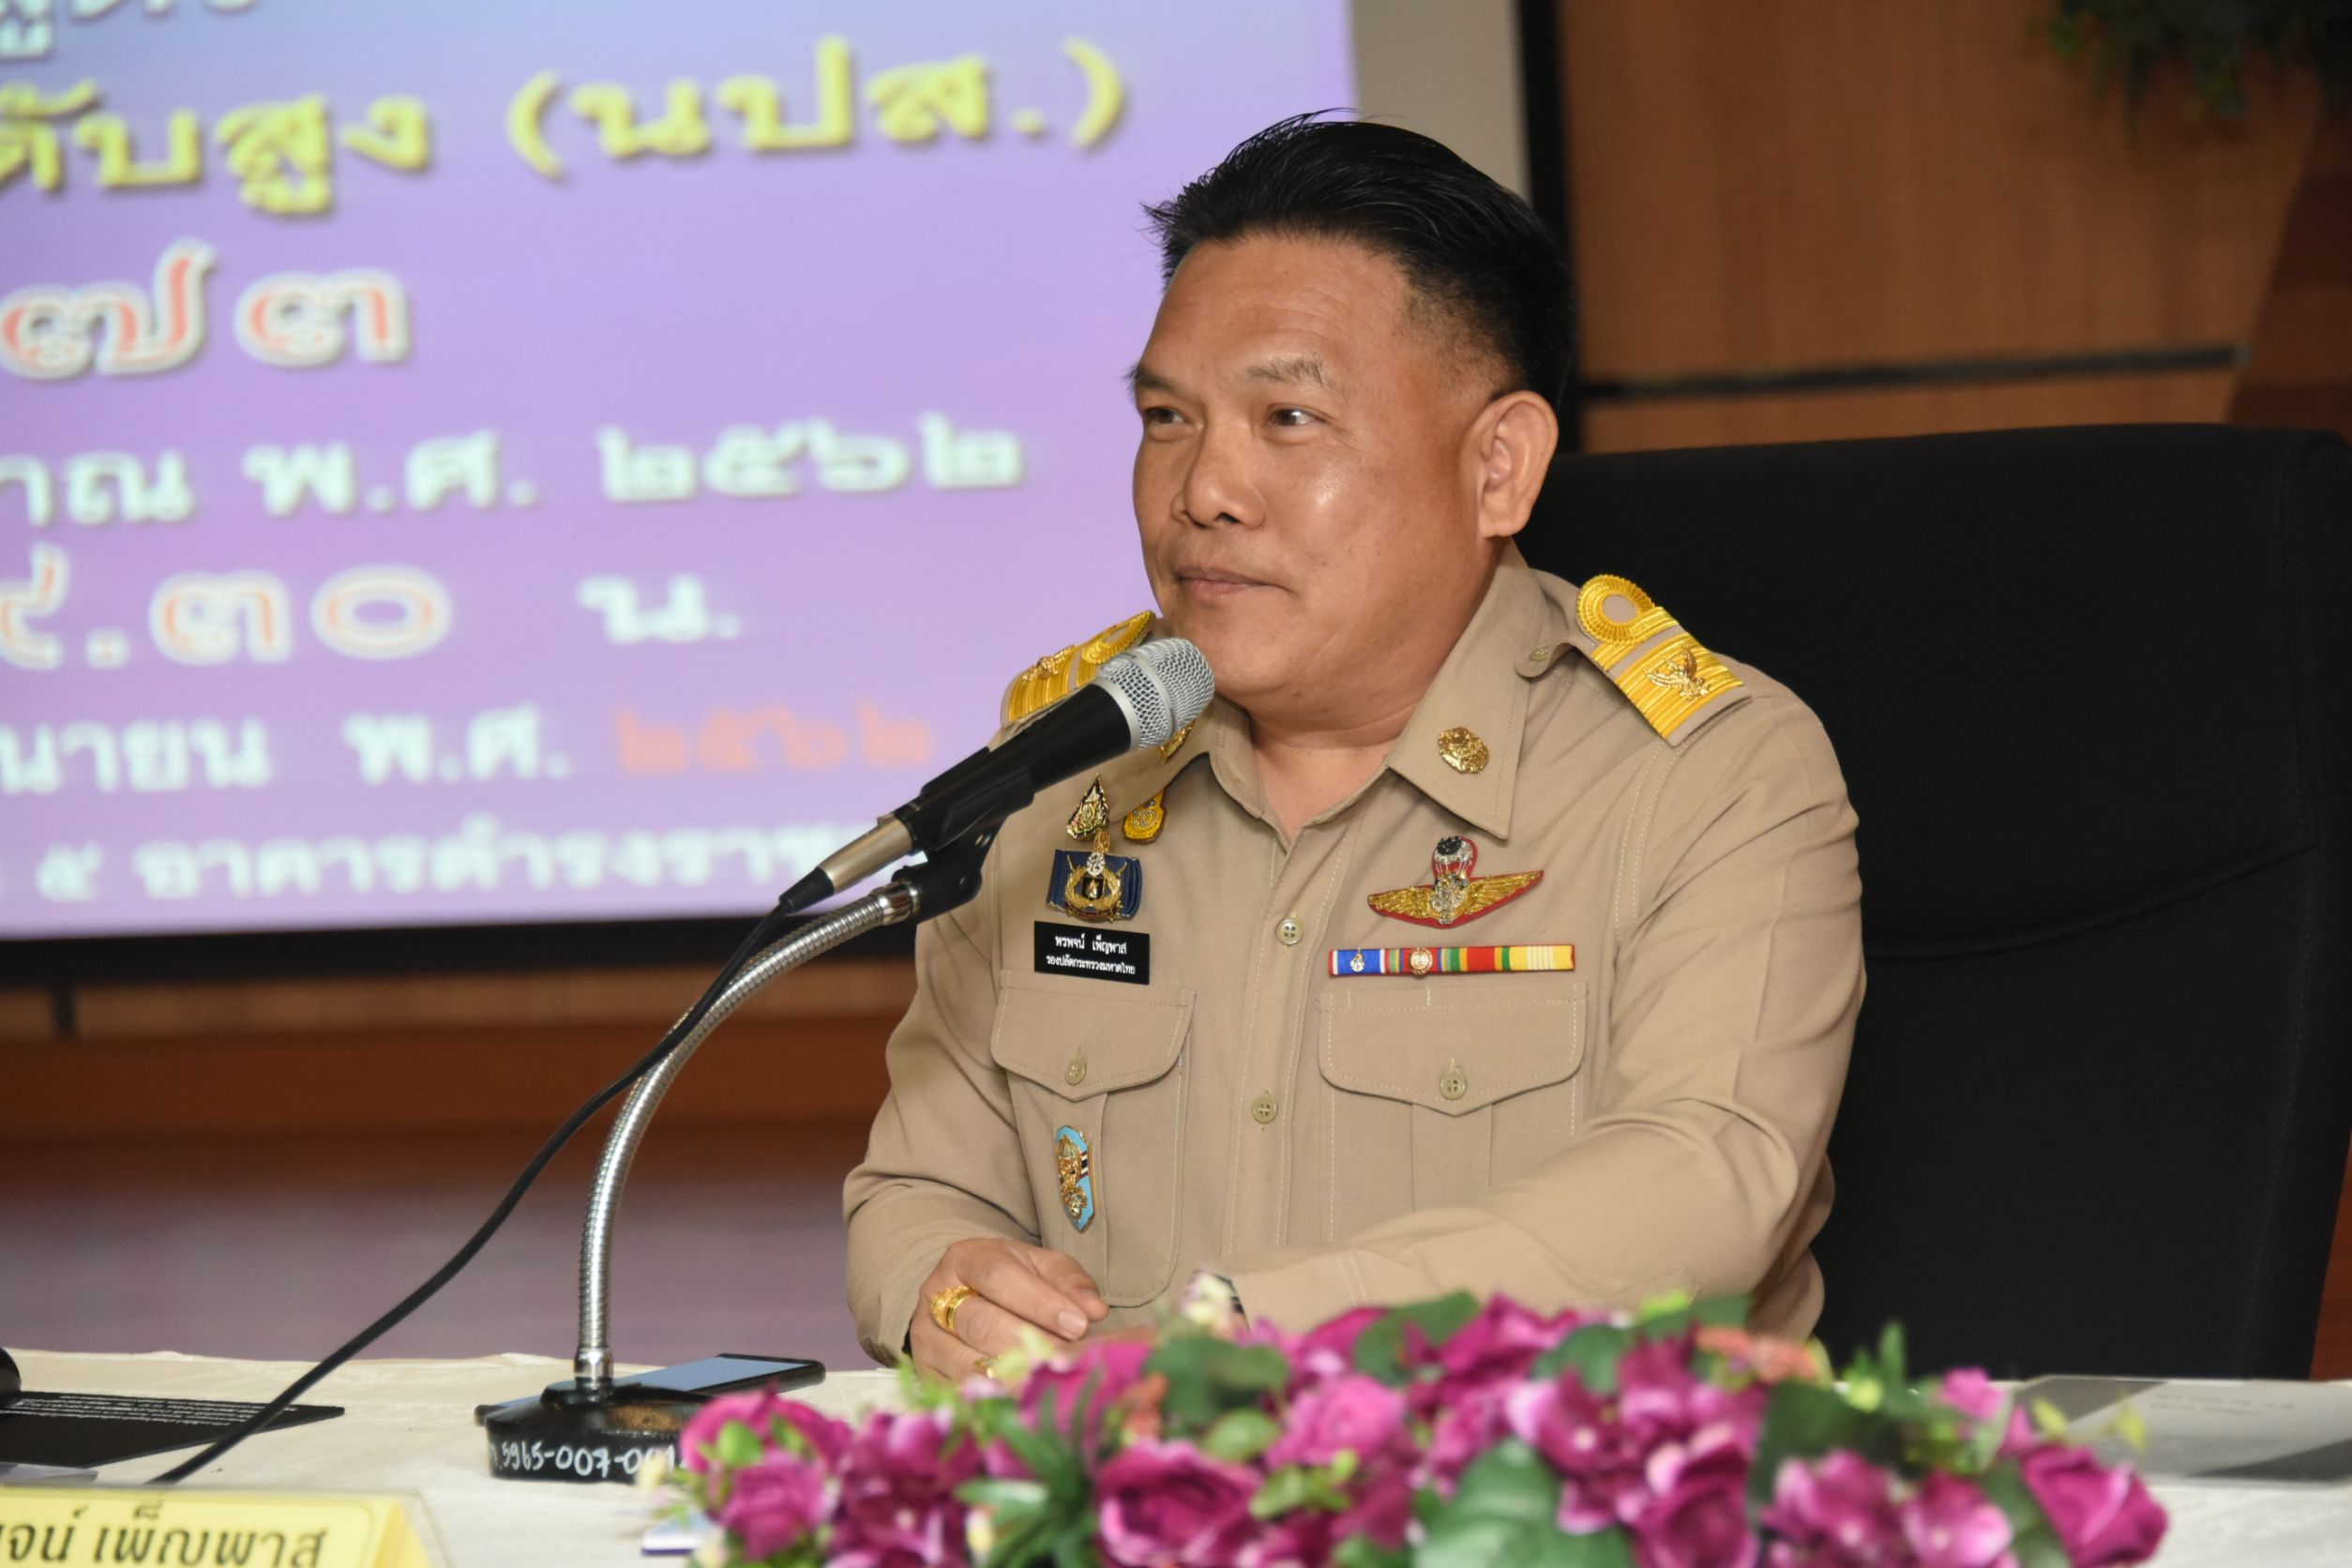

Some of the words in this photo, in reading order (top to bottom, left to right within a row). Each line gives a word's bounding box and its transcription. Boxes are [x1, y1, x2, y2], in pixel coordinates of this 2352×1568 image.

[506, 34, 1125, 181] (นปส.)
[242, 428, 538, 517] พ.ศ.
[598, 411, 1024, 504] ๒๕๖๒
[576, 572, 742, 644] น.
[341, 701, 574, 786] พ.ศ.
[0, 1504, 88, 1563] จน์
